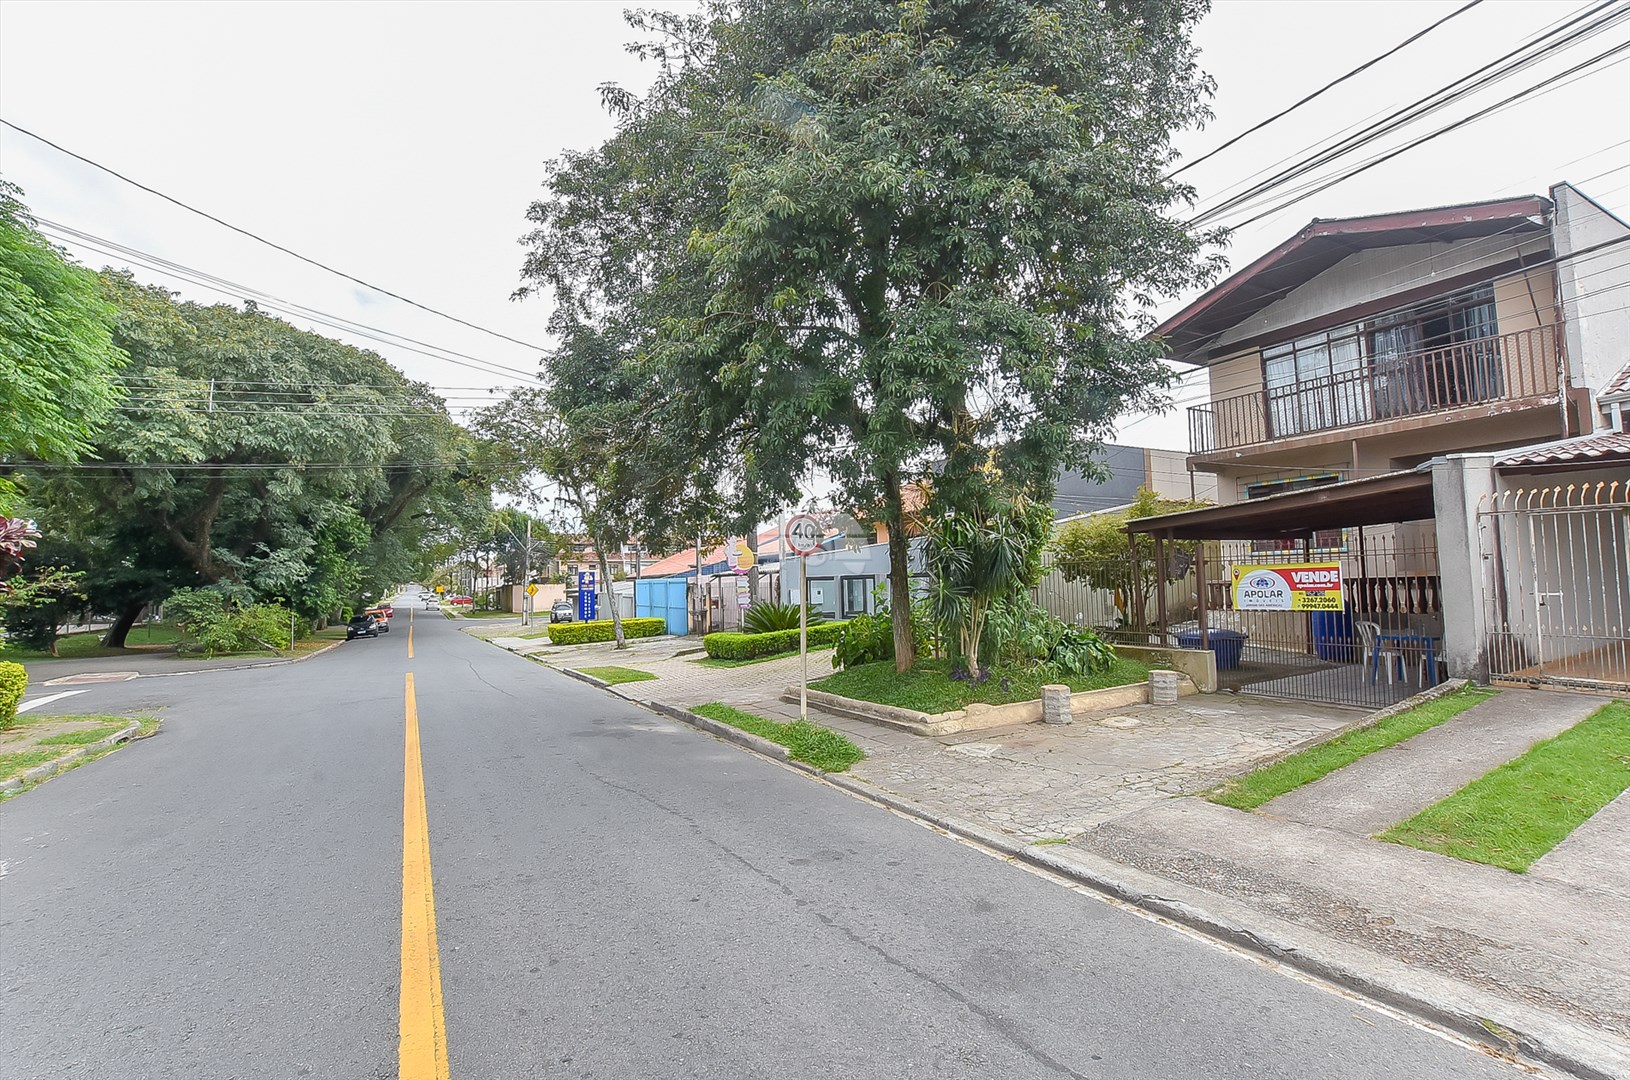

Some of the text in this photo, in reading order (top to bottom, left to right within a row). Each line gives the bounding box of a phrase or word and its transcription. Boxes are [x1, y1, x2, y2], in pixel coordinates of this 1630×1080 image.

[792, 523, 815, 540] 40
[1291, 571, 1338, 582] VENDE
[1244, 590, 1283, 598] APOLAR
